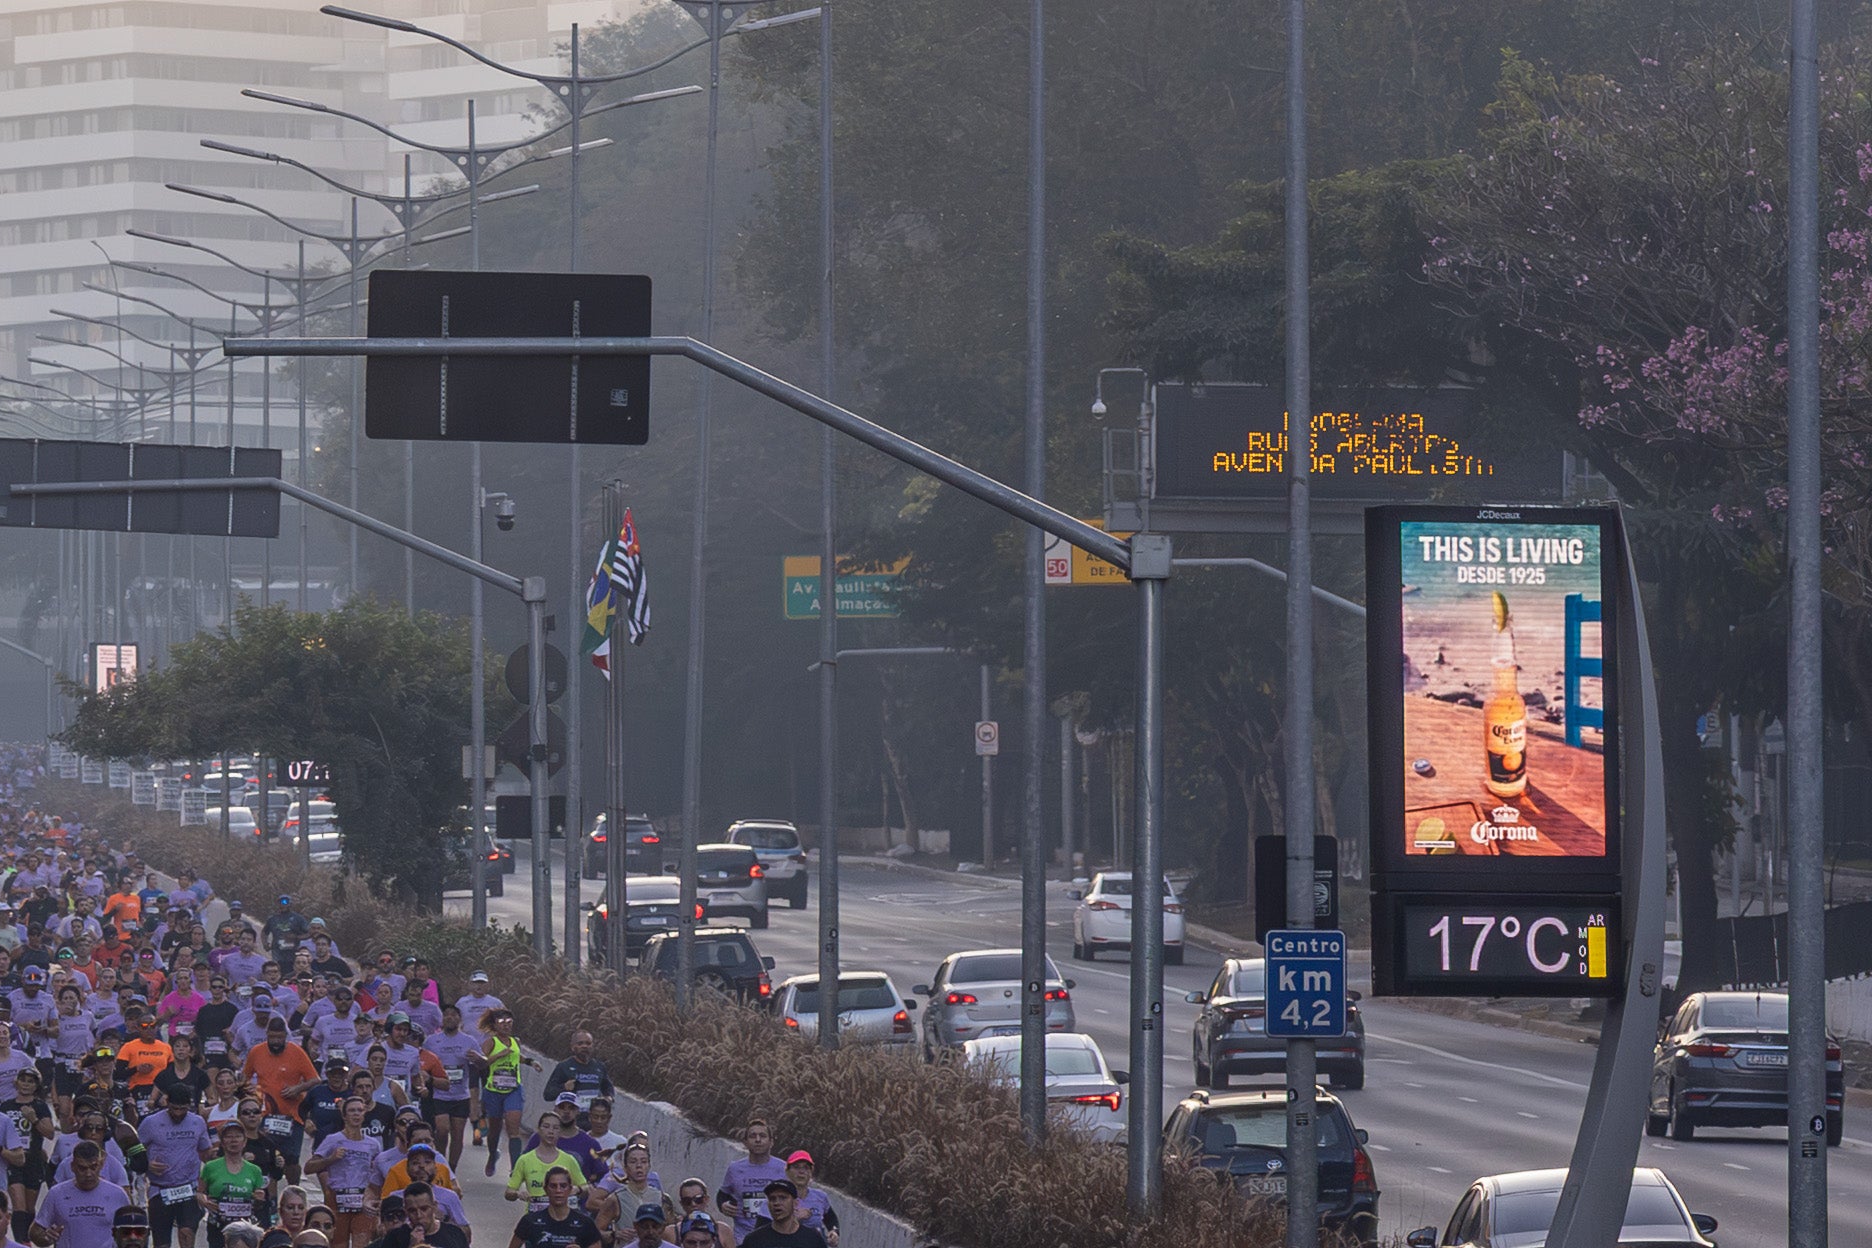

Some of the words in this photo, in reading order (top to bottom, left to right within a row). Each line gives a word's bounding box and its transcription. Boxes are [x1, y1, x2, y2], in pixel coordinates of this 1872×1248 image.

[1476, 509, 1521, 520] JCDecaux
[1418, 536, 1475, 562] THIS
[1478, 537, 1502, 563] IS
[1506, 538, 1584, 565] LIVING
[1047, 560, 1068, 574] 50
[1457, 566, 1506, 584] DESDE
[1509, 567, 1546, 585] 1925
[1470, 820, 1540, 847] Corona
[1587, 913, 1605, 927] AR
[1270, 936, 1341, 954] Centro
[1428, 914, 1572, 974] 17°C
[1278, 964, 1332, 992] km
[1279, 998, 1332, 1031] 4,2
